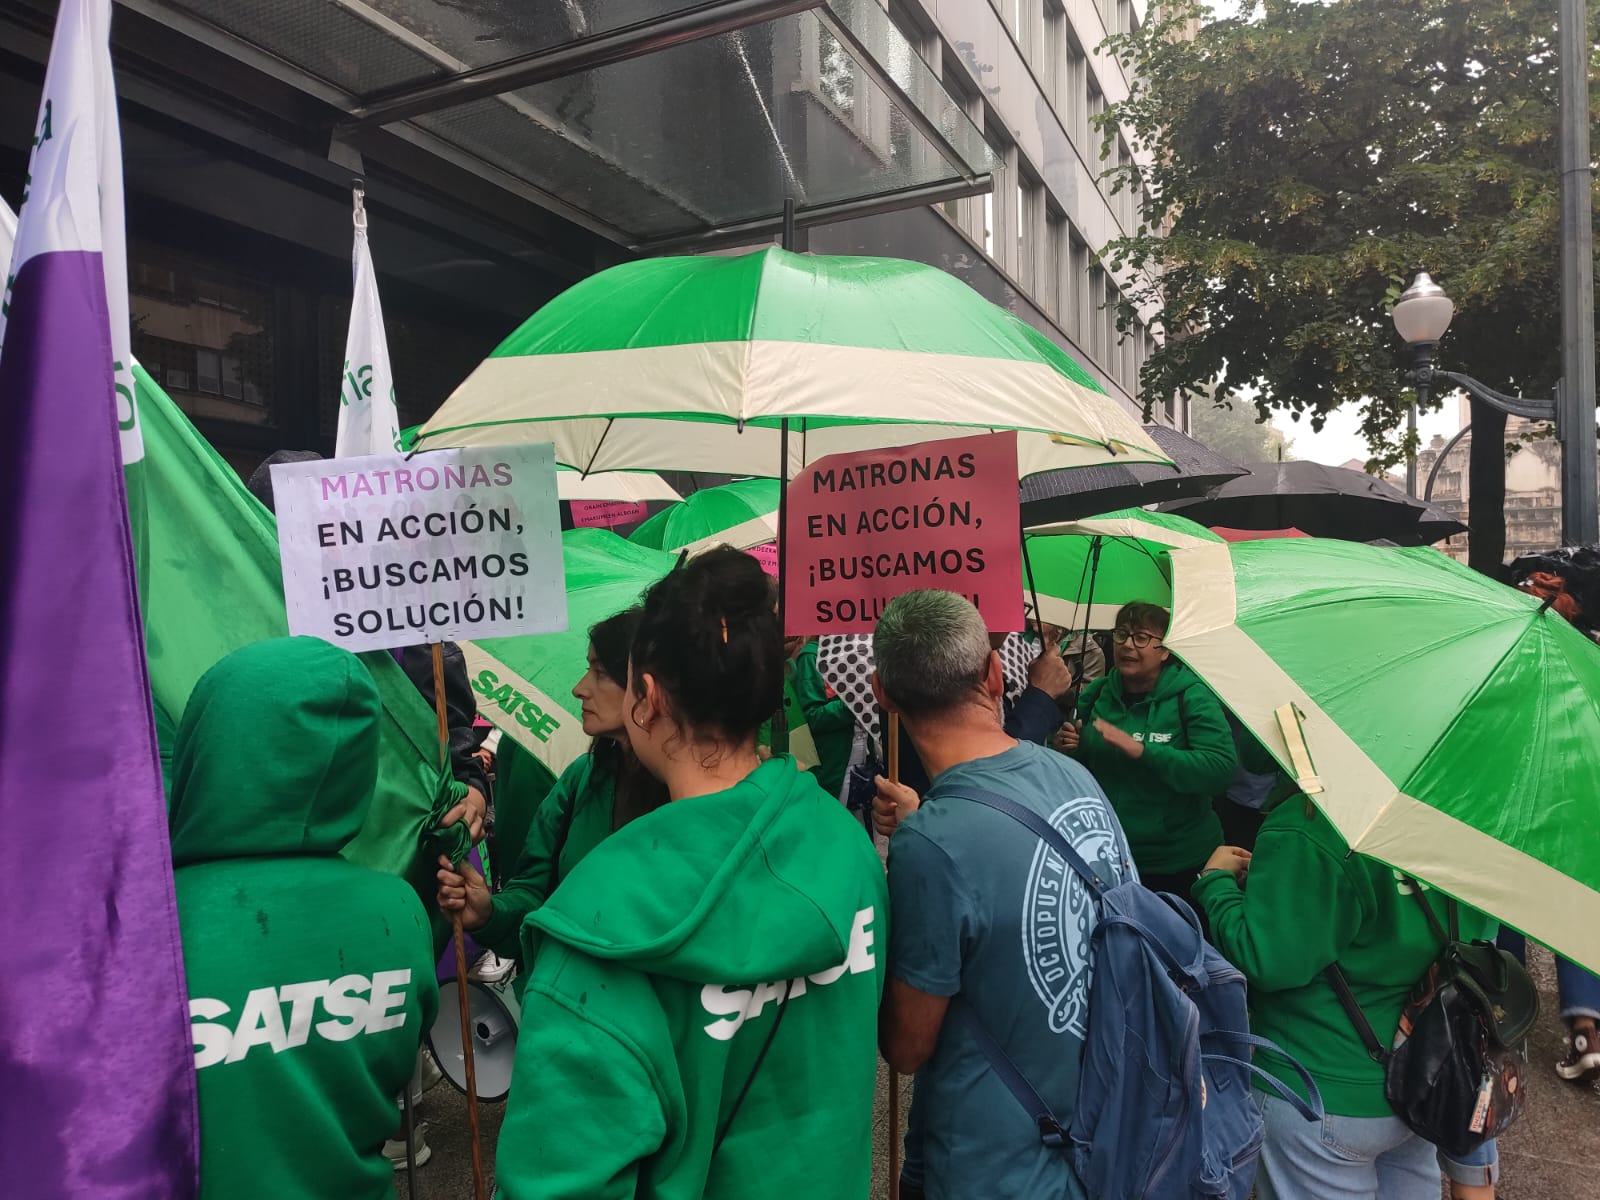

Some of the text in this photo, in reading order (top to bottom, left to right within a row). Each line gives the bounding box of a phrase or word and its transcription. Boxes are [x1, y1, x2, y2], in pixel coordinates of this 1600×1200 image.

[321, 462, 513, 501] MATRONAS
[813, 453, 976, 493] MATRONAS
[317, 503, 524, 547] EN ACCIÓN,
[807, 497, 983, 538] EN ACCIÓN,
[322, 552, 530, 600] ¡BUSCAMOS
[809, 548, 986, 588] ¡BUSCAMOS
[333, 594, 525, 637] SOLUCIÓN!
[471, 669, 561, 744] SATSE
[1037, 876, 1065, 983] OCTOPUS
[190, 968, 411, 1070] SATSE
